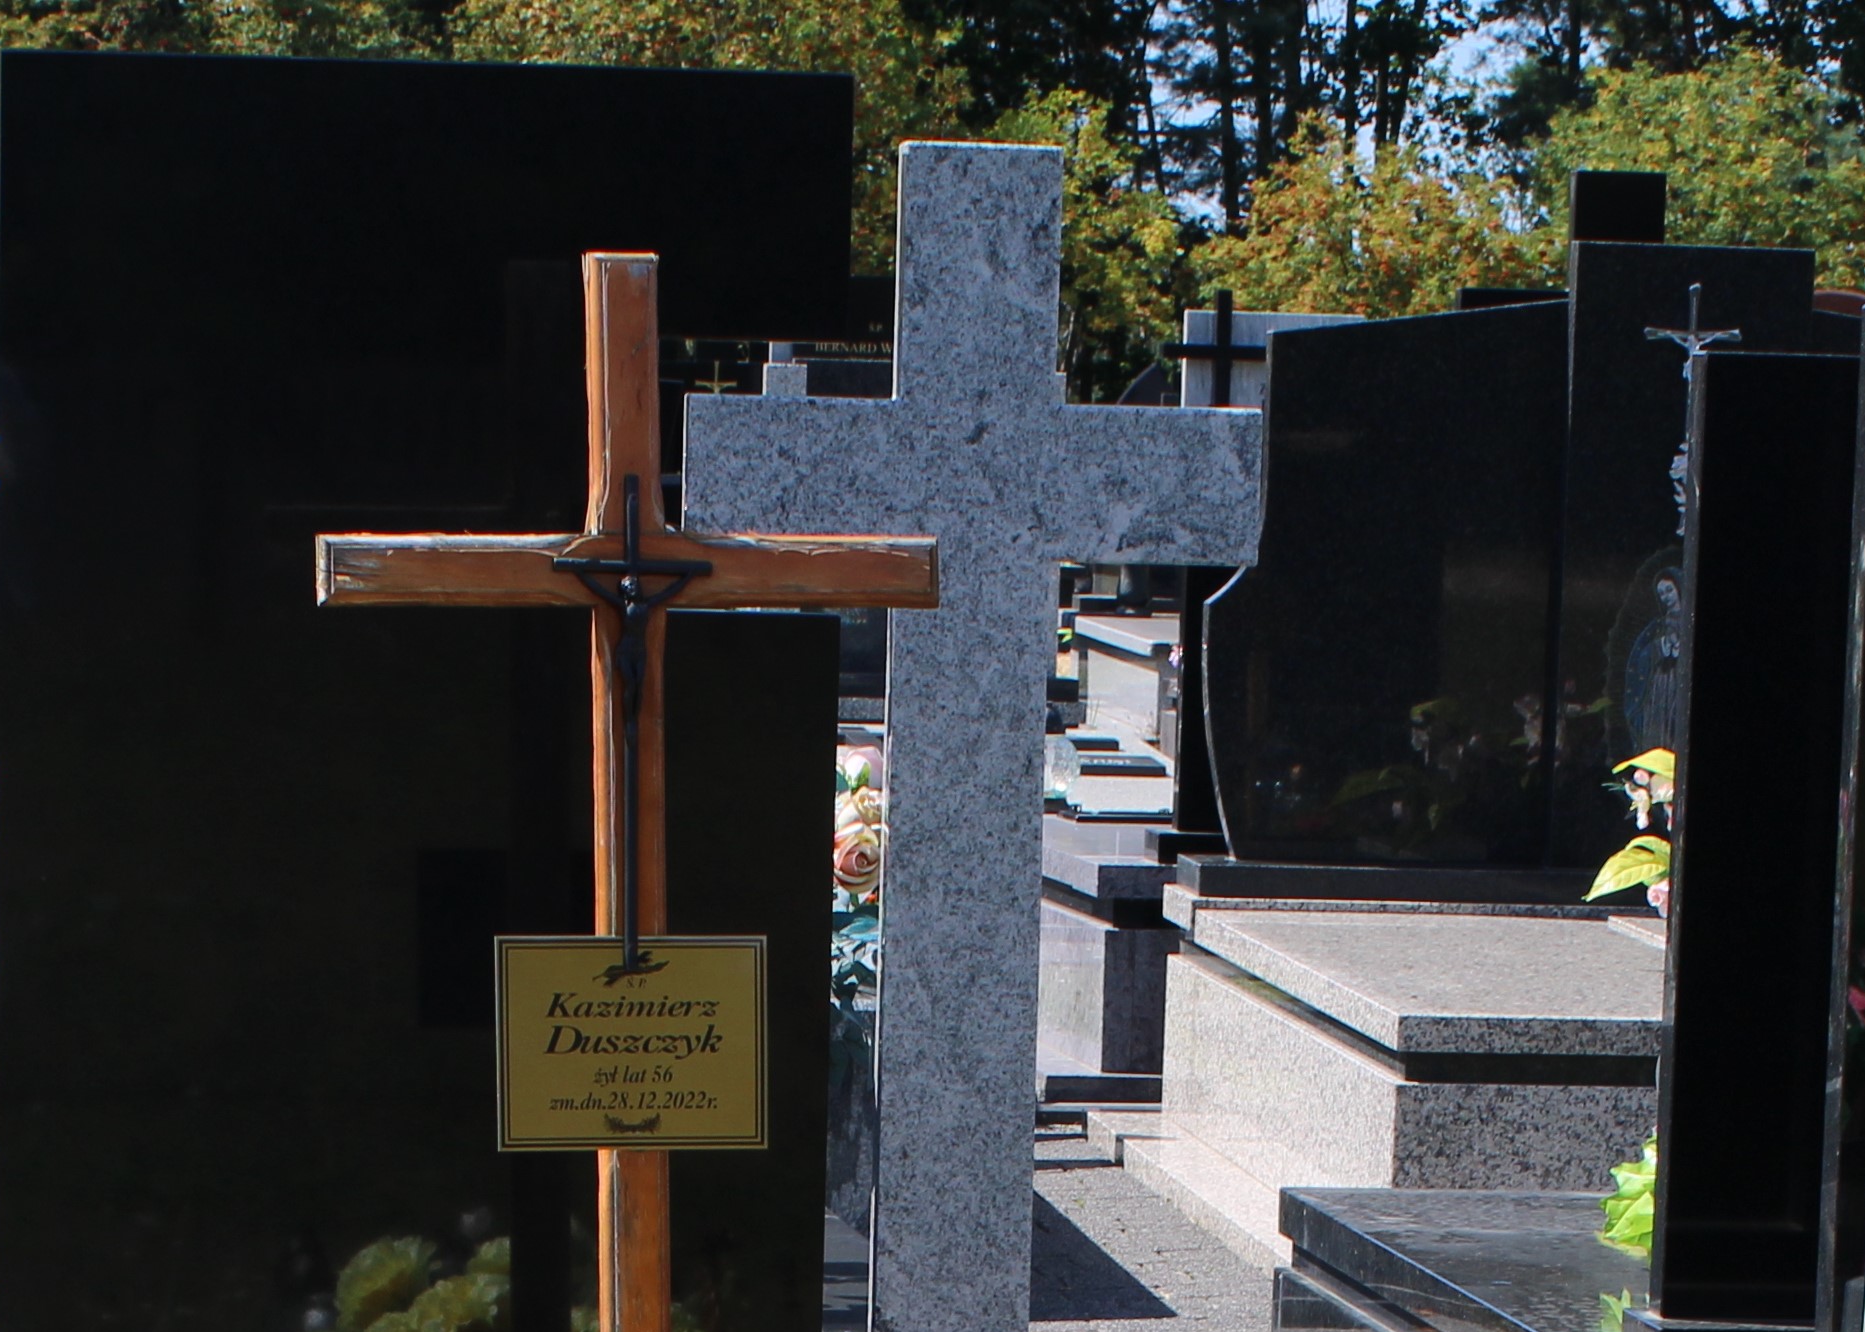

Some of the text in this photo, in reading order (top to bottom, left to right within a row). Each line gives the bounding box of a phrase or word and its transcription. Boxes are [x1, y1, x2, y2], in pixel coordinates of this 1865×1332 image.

[546, 992, 720, 1019] Kazimierz
[544, 1023, 723, 1060] Duszczyk
[592, 1065, 673, 1088] żył lat 56
